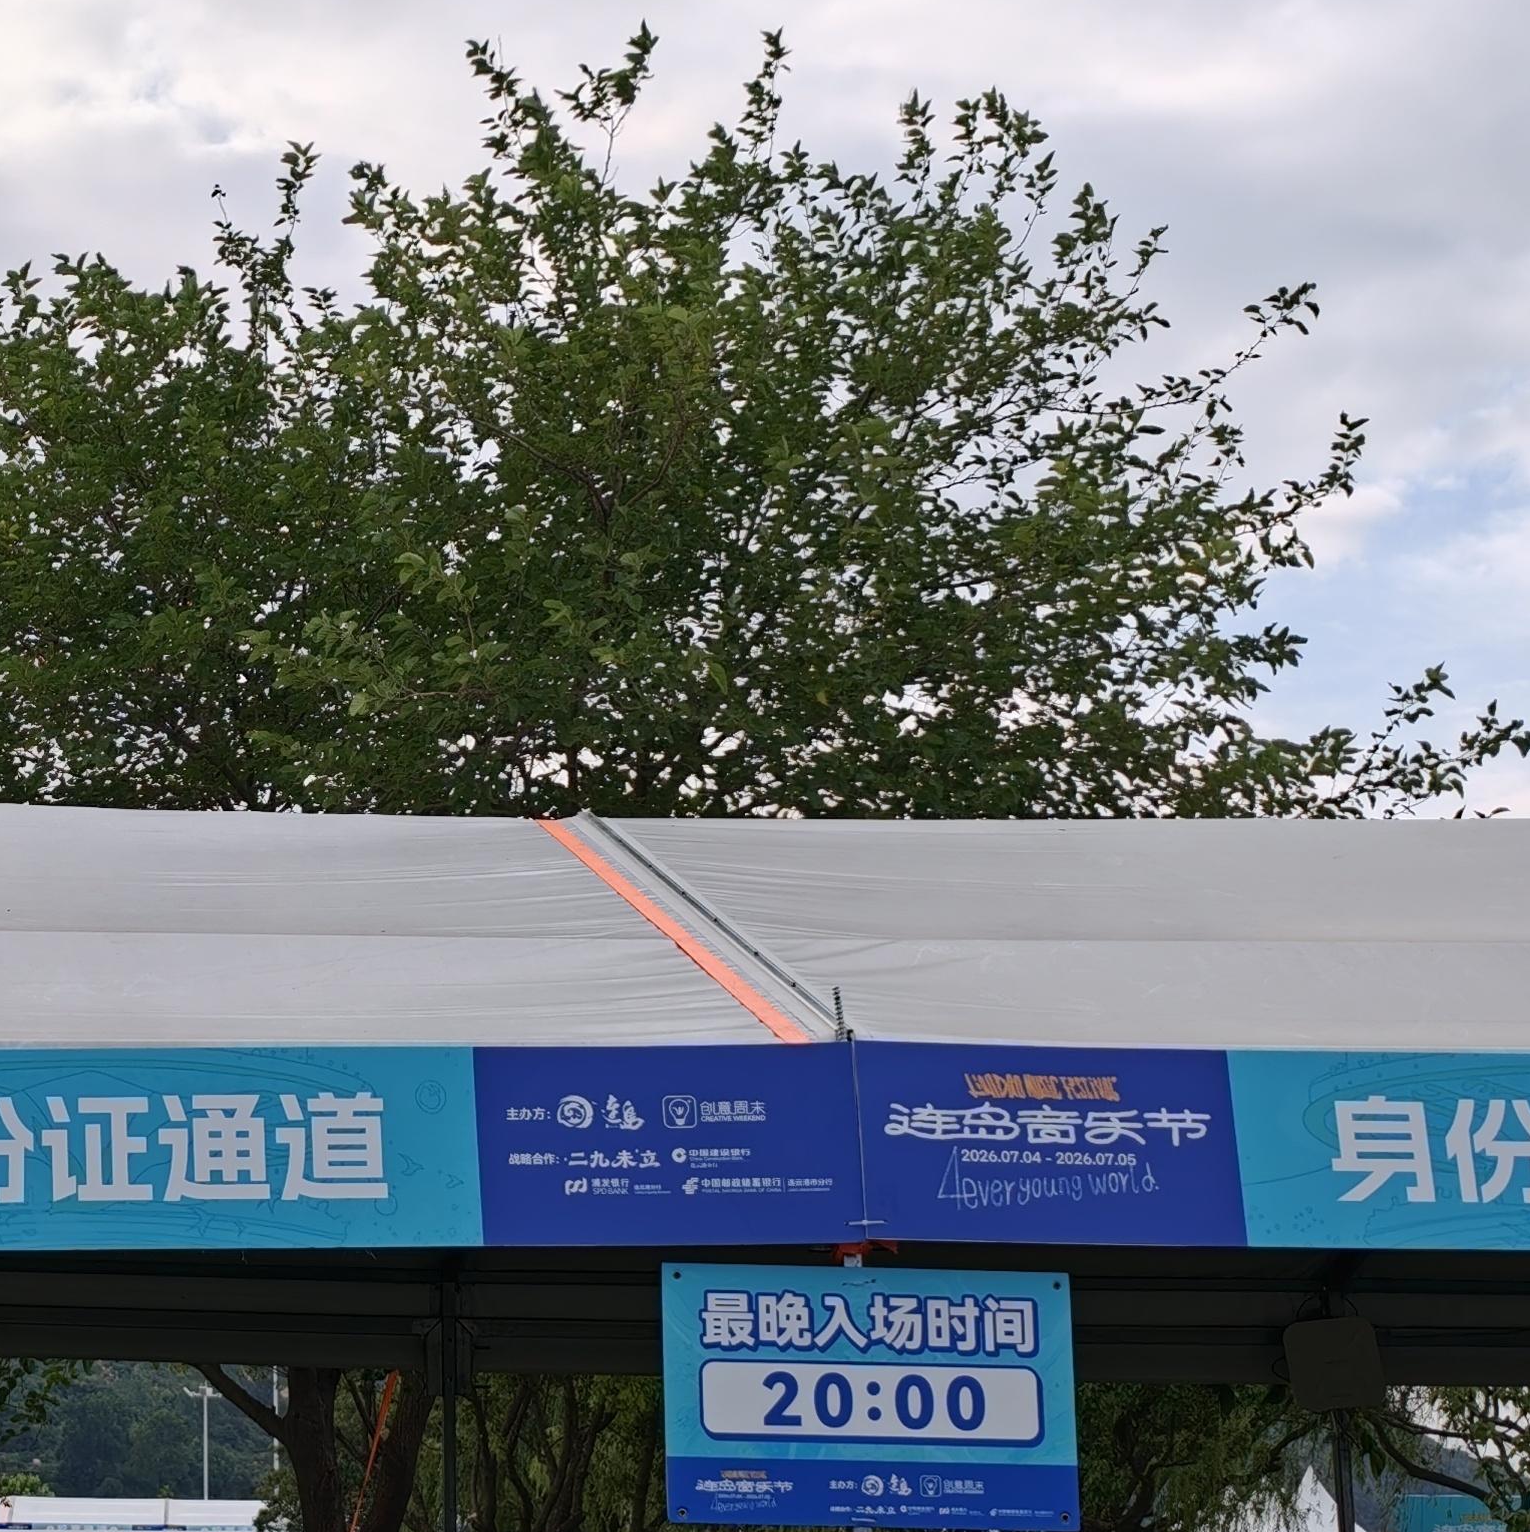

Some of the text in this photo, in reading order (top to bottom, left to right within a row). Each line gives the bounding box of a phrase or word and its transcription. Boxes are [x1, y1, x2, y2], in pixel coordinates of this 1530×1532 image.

[700, 1101, 765, 1115] 创意周末
[884, 1102, 1210, 1146] 连岛音乐节
[961, 1150, 1041, 1164] 2026.07.04
[1056, 1152, 1136, 1166] 2026.07.05
[701, 1291, 1036, 1356] 最晚入场时间
[763, 1372, 985, 1432] 20:00
